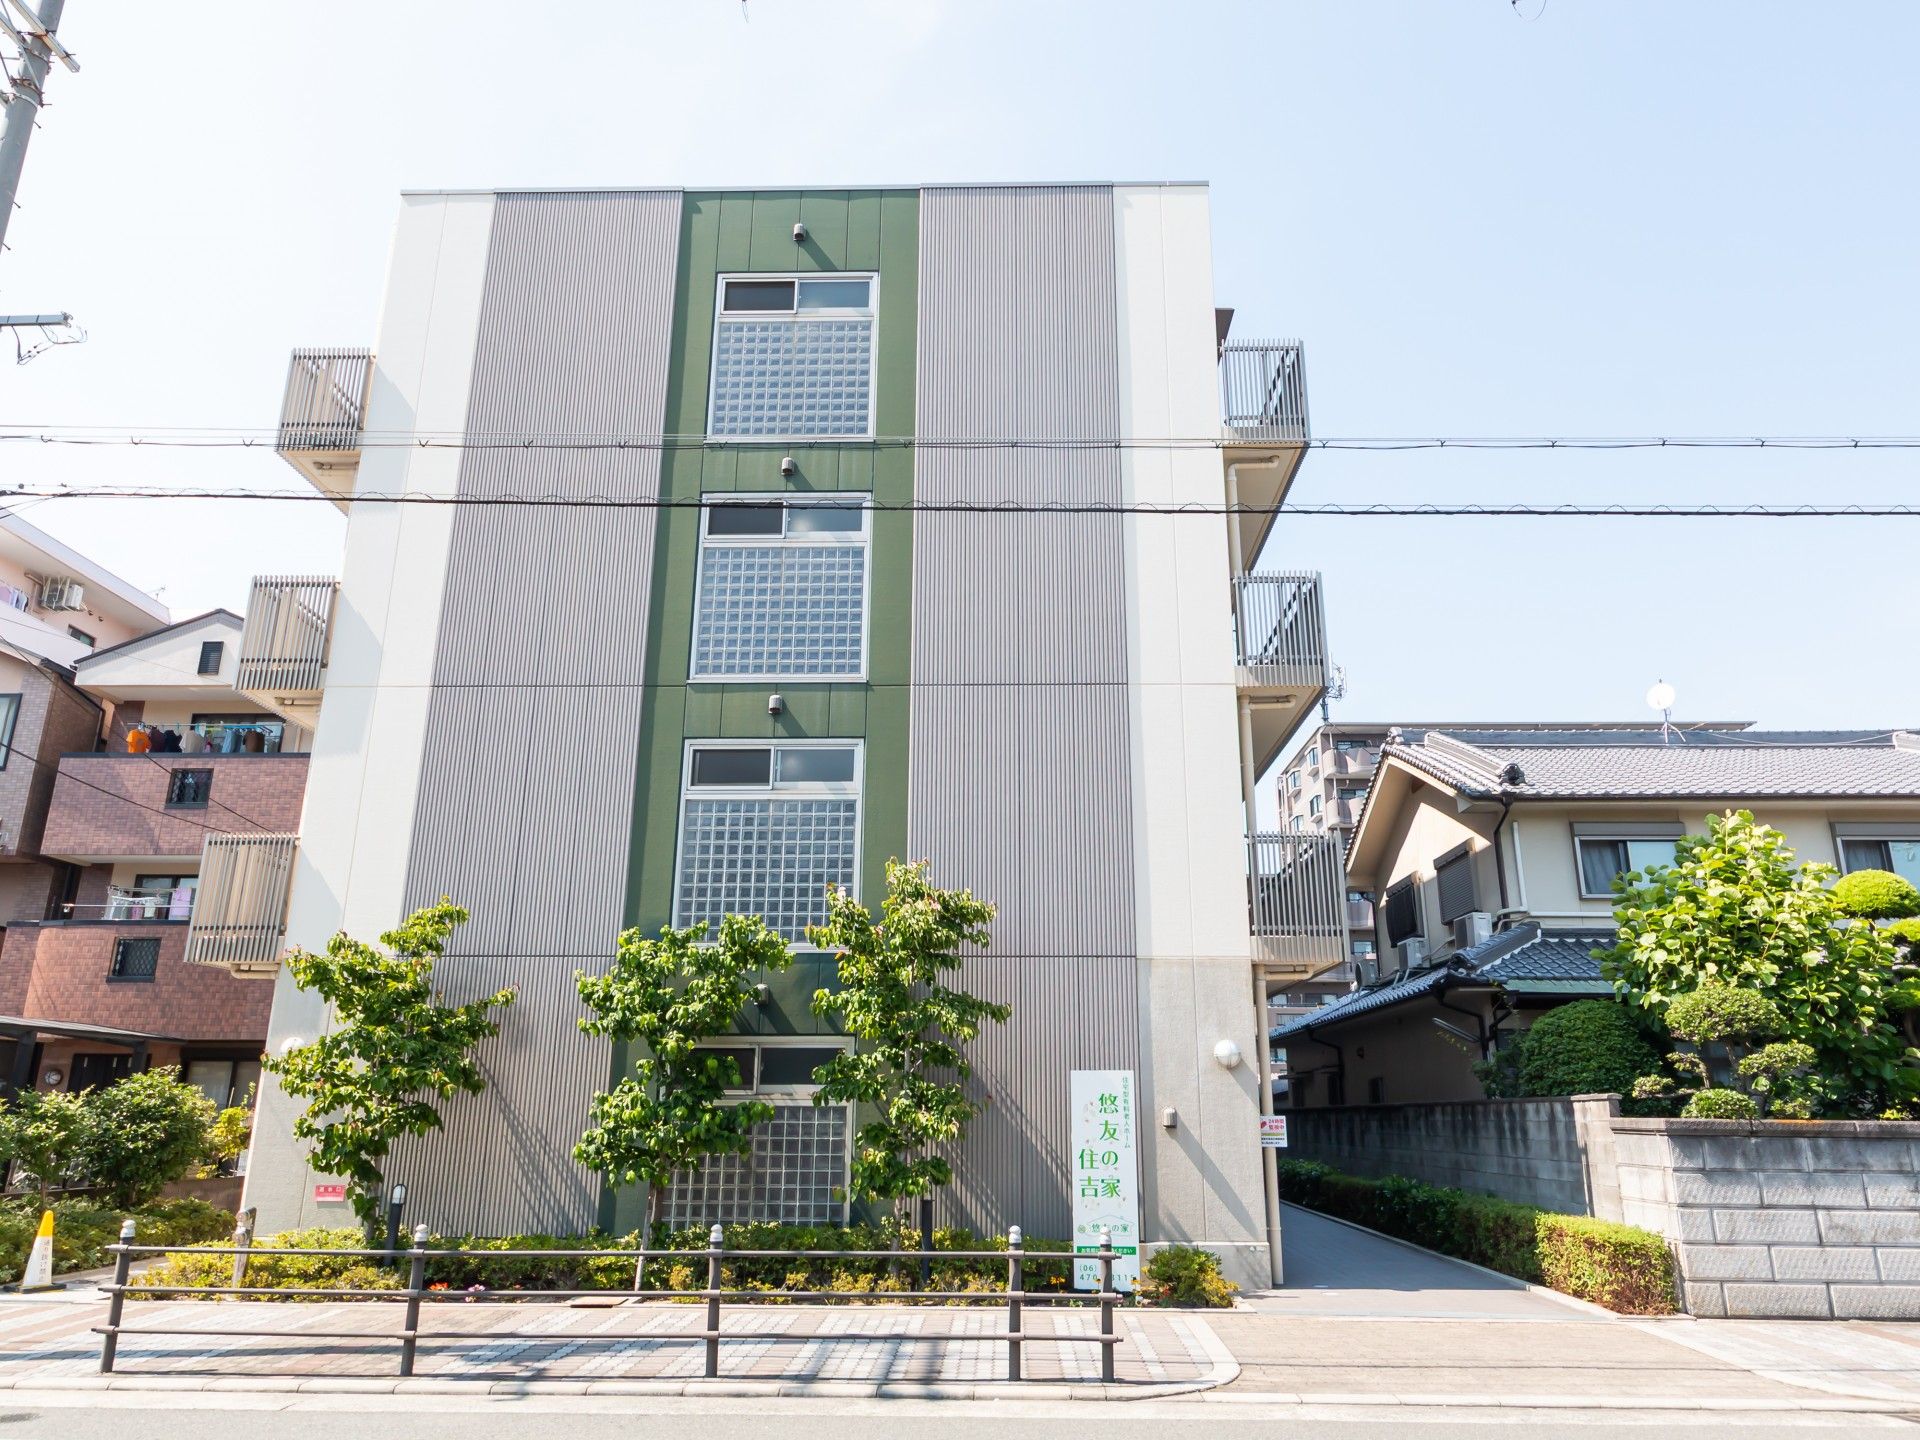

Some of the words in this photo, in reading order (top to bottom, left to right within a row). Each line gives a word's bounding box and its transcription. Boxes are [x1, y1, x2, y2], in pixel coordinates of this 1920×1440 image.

[1079, 1149, 1099, 1198] 住吉
[1099, 1093, 1120, 1198] 悠友の家
